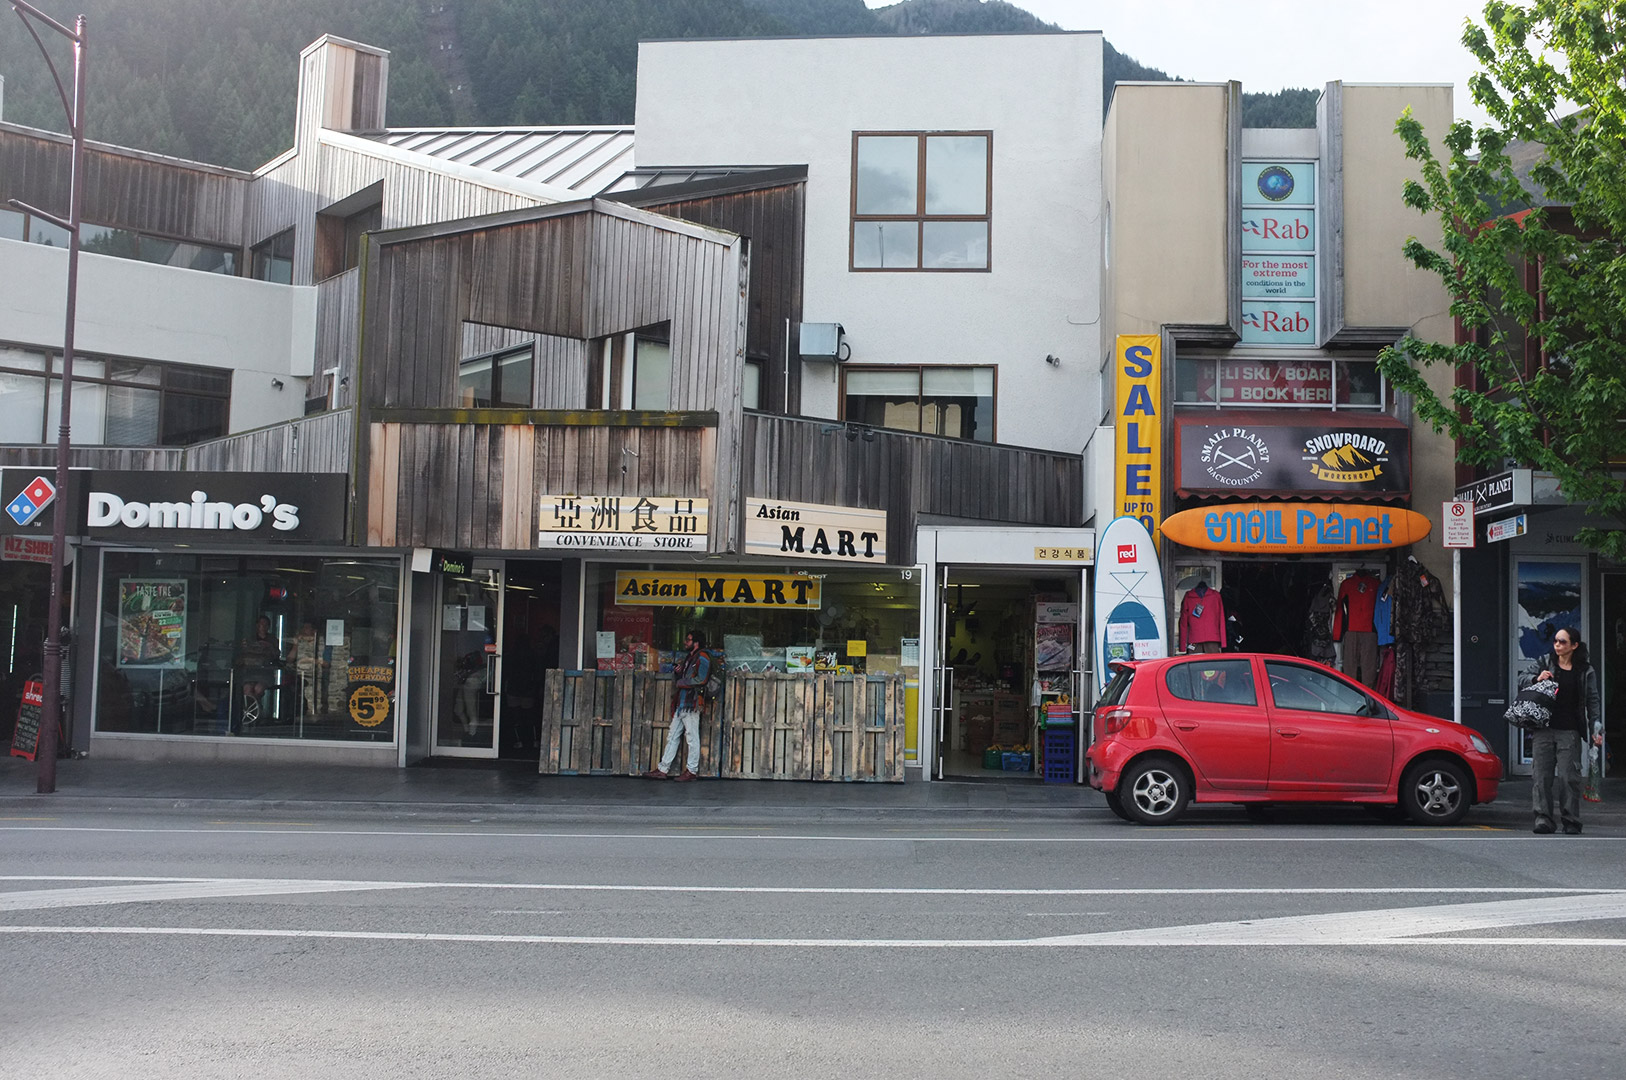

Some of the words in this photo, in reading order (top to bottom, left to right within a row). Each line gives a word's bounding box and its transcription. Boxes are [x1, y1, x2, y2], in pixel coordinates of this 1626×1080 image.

[1262, 218, 1309, 240] Rab
[1242, 260, 1259, 268] For
[1262, 260, 1279, 269] the
[1281, 261, 1308, 269] most
[1262, 310, 1309, 332] Rab
[1242, 367, 1270, 380] SKI
[1241, 387, 1289, 400] BOOK
[1123, 345, 1156, 496] SALE
[1201, 429, 1230, 463] SMALL
[1233, 428, 1270, 463] PLANET
[1305, 432, 1386, 455] SNOWBOARD
[1206, 466, 1263, 486] BACKCOUNTRY
[1323, 472, 1369, 480] WORKSHOP
[1489, 476, 1512, 496] PLANET
[552, 496, 697, 532] 亞洲食品
[756, 504, 800, 521] Asian
[1124, 502, 1138, 513] UP
[1140, 502, 1154, 513] TO
[4, 537, 22, 552] NZ
[556, 534, 643, 548] CONVENIENCE
[653, 536, 694, 549] STORE
[780, 525, 879, 558] MART
[1119, 545, 1136, 559] red
[900, 569, 912, 580] 19
[136, 585, 157, 597] TASTE
[159, 585, 172, 597] THE
[622, 578, 687, 597] Asian
[697, 577, 813, 605] MART
[348, 666, 393, 676] CHEAPER
[349, 674, 392, 682] EVERYDAY
